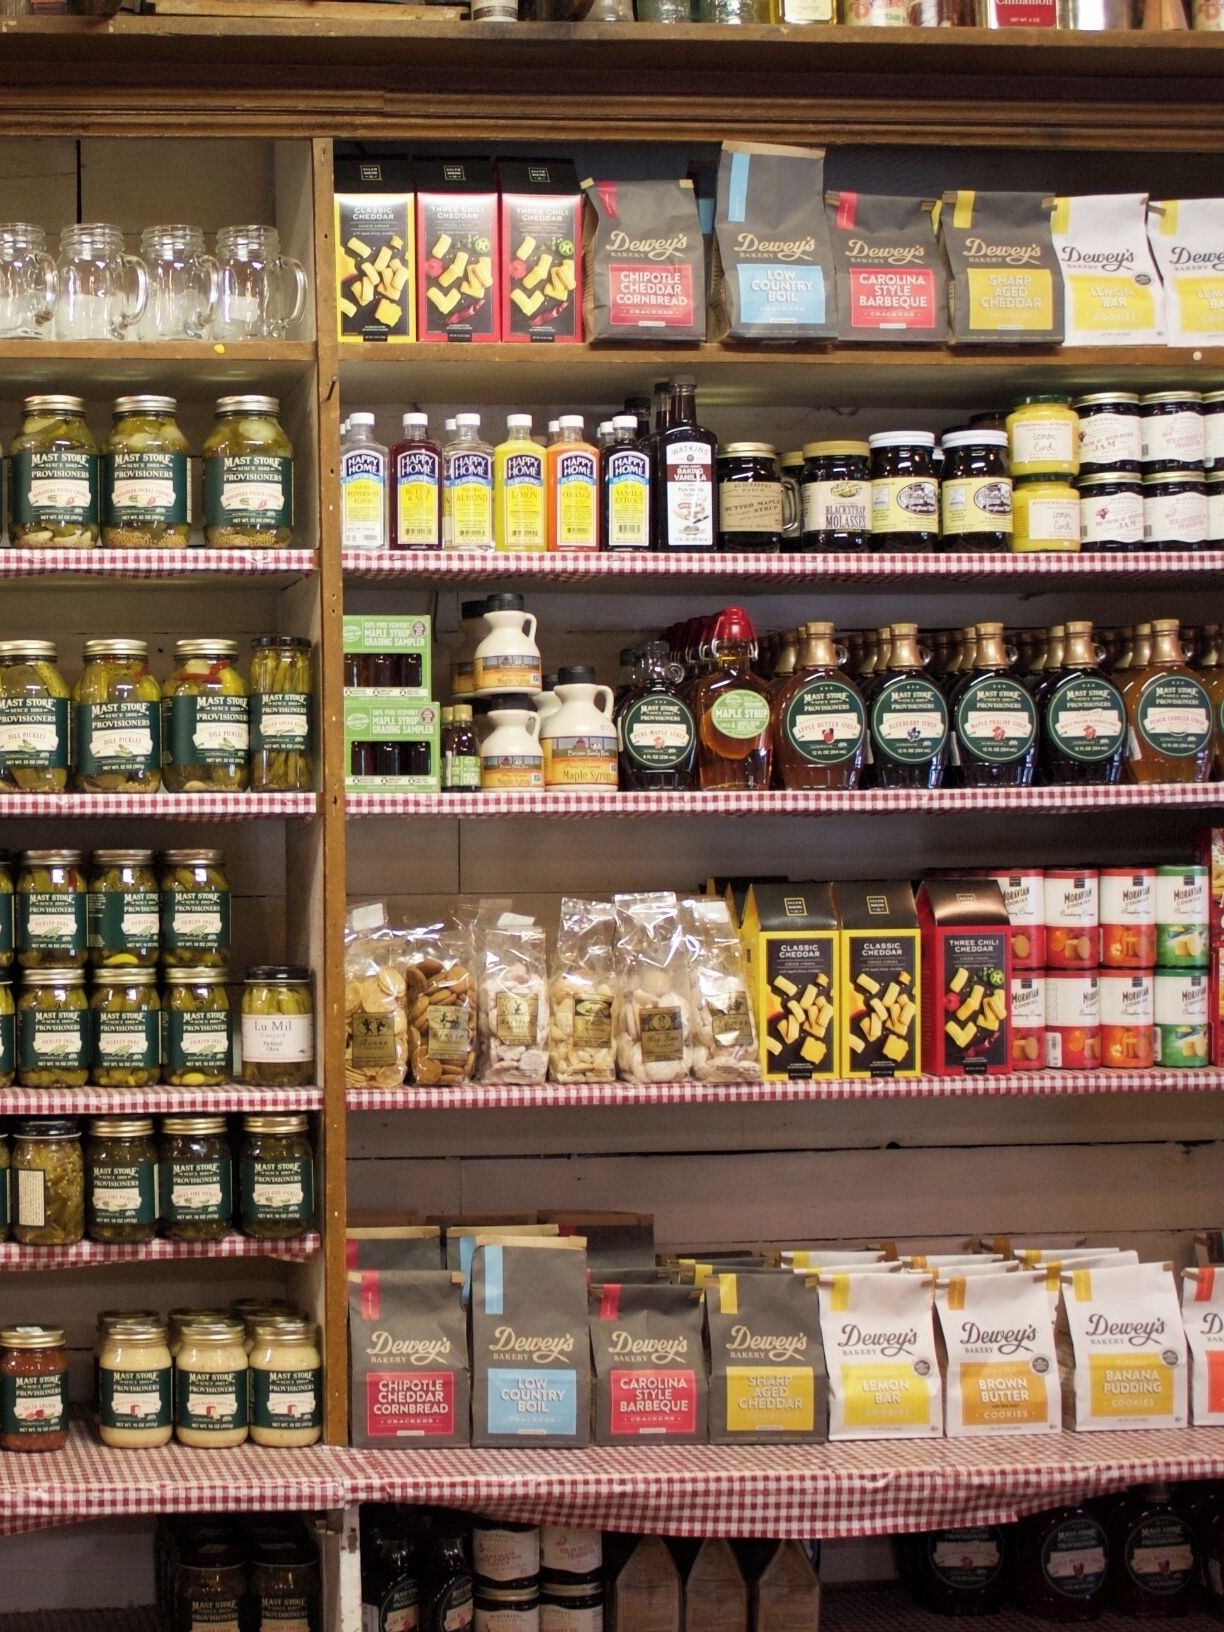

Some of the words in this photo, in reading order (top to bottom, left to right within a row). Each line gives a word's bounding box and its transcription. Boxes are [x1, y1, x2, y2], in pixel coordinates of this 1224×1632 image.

[606, 231, 687, 262] Dewey's
[734, 233, 816, 261] Dewey's
[845, 239, 925, 265] Dewey's
[963, 238, 1041, 265] Dewey's
[1061, 246, 1136, 272] Dewey's
[621, 272, 681, 283] CHIPOTLE
[767, 270, 796, 280] LOW
[859, 274, 925, 286] CAROLINA
[751, 281, 813, 291] COUNTRY
[989, 276, 1030, 287] SHARP
[621, 283, 682, 295] CHEDDAR
[875, 286, 911, 296] STYLE
[994, 287, 1028, 297] AGED
[616, 295, 687, 307] CORNBREAD
[768, 291, 798, 302] BOIL
[859, 296, 927, 308] BARBEQUE
[1103, 297, 1127, 307] BAR
[981, 297, 1043, 308] CHEDDAR
[31, 454, 59, 466] MAST
[62, 454, 89, 466] STORE
[348, 458, 378, 466] HAPPY
[401, 456, 431, 467] HAPPY
[455, 457, 485, 468] HAPPY
[508, 458, 538, 469] HAPPY
[563, 458, 592, 468] HAPPY
[615, 457, 643, 467] HAPPY
[348, 464, 378, 474] HOME
[402, 465, 432, 475] HOME
[455, 467, 486, 476] HOME
[508, 467, 539, 477] HOME
[563, 465, 592, 474] HOME
[615, 465, 645, 474] HOME
[31, 471, 89, 479] PROVISIONERS
[825, 506, 865, 515] BLACKSTRAP
[826, 514, 865, 527] MOLASSES
[365, 629, 388, 637] MAPLE
[394, 638, 424, 646] SAMPLER
[716, 709, 742, 718] MAPLE
[745, 709, 769, 719] SYRUP
[373, 717, 395, 725] MAPLE
[398, 717, 418, 725] SYRUP
[30, 894, 49, 903] MAST
[52, 894, 75, 903] STORE
[1064, 887, 1092, 904] MORAVIAN
[1122, 886, 1150, 903] MORAVIAN
[254, 1020, 267, 1031] Lu
[271, 1020, 292, 1031] Mil
[1086, 1314, 1166, 1346] Dewey's
[726, 1325, 808, 1361] Dewey's
[838, 1324, 919, 1357] Dewey's
[960, 1322, 1038, 1354] Dewey's
[1091, 1337, 1124, 1345] BAKERY
[366, 1331, 451, 1365] Dewey's
[489, 1327, 574, 1362] Dewey's
[608, 1331, 687, 1364] Dewey's
[493, 1353, 529, 1361] BAKERY
[613, 1354, 646, 1362] BAKERY
[748, 1376, 792, 1387] SHARP
[1106, 1370, 1159, 1382] BANANA
[379, 1380, 443, 1391] CHIPOTLE
[516, 1377, 547, 1389] LOW
[620, 1378, 687, 1389] CAROLINA
[862, 1380, 908, 1391] LEMON
[979, 1378, 1028, 1390] BROWN
[1104, 1382, 1162, 1393] PUDDING
[379, 1391, 444, 1403] CHEDDAR
[500, 1389, 565, 1400] COUNTRY
[635, 1389, 672, 1400] STYLE
[753, 1387, 787, 1398] AGED
[981, 1390, 1029, 1402] BUTTER
[739, 1398, 803, 1410] CHEDDAR
[874, 1392, 900, 1405] BAR
[1111, 1399, 1154, 1407] COOKIES
[373, 1403, 448, 1415] CORNBREAD
[517, 1400, 549, 1413] BOIL
[620, 1400, 688, 1412] BARBEQUE
[984, 1410, 1028, 1419] COOKIES
